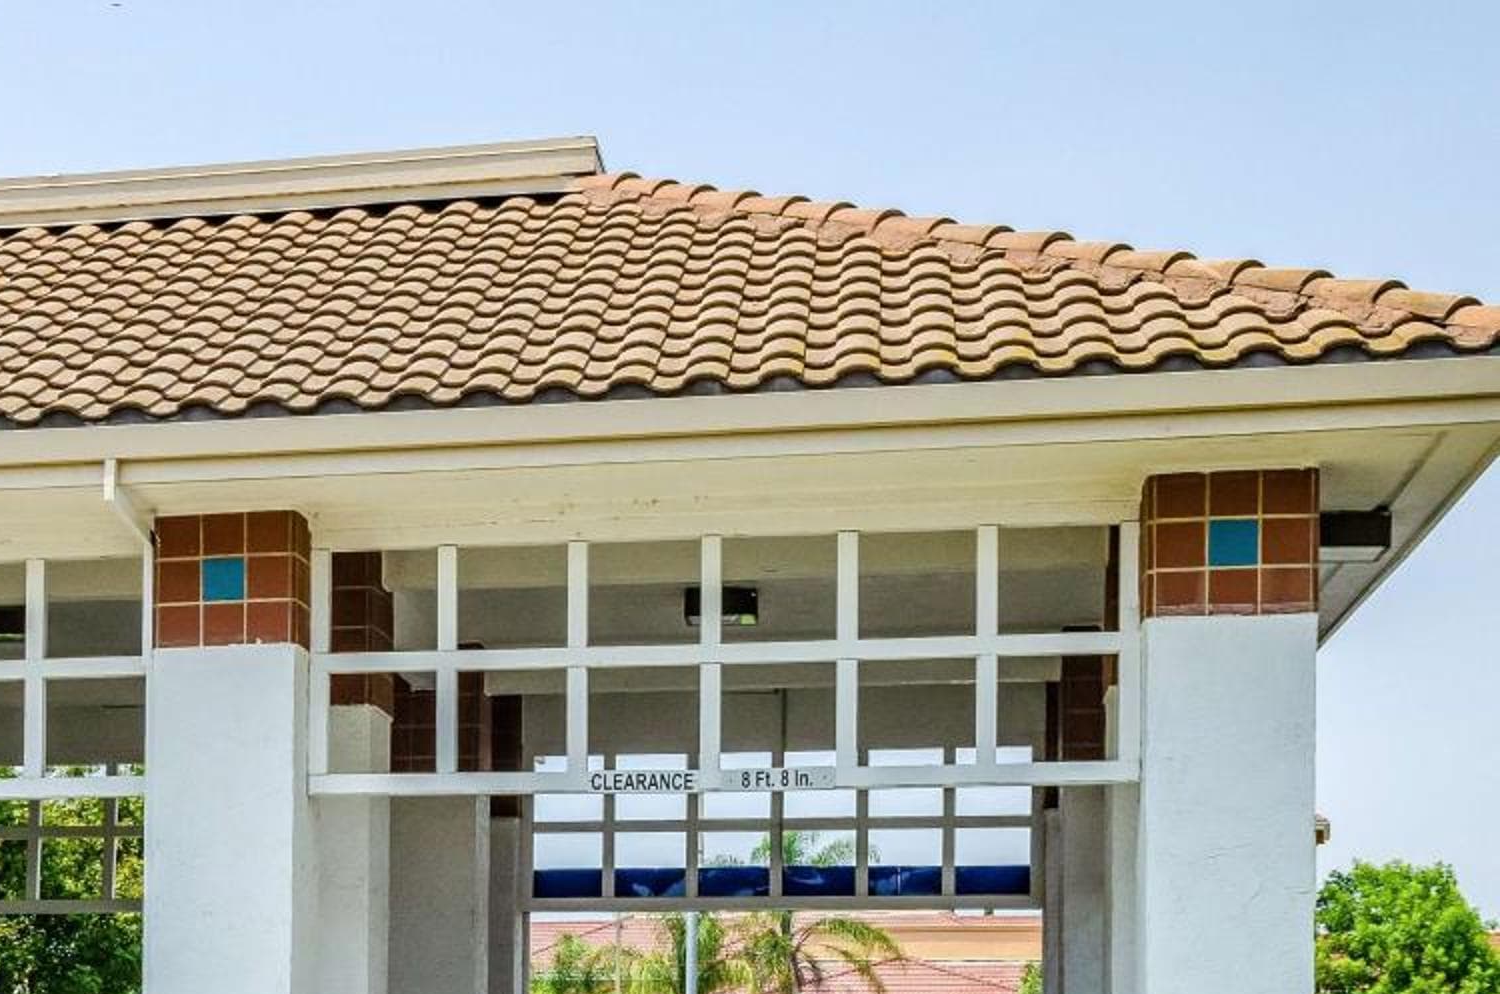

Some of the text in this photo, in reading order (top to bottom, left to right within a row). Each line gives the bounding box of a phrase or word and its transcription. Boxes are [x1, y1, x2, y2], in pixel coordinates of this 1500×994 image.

[590, 770, 813, 791] CLEARANCE 8 Ft. 8 In.
